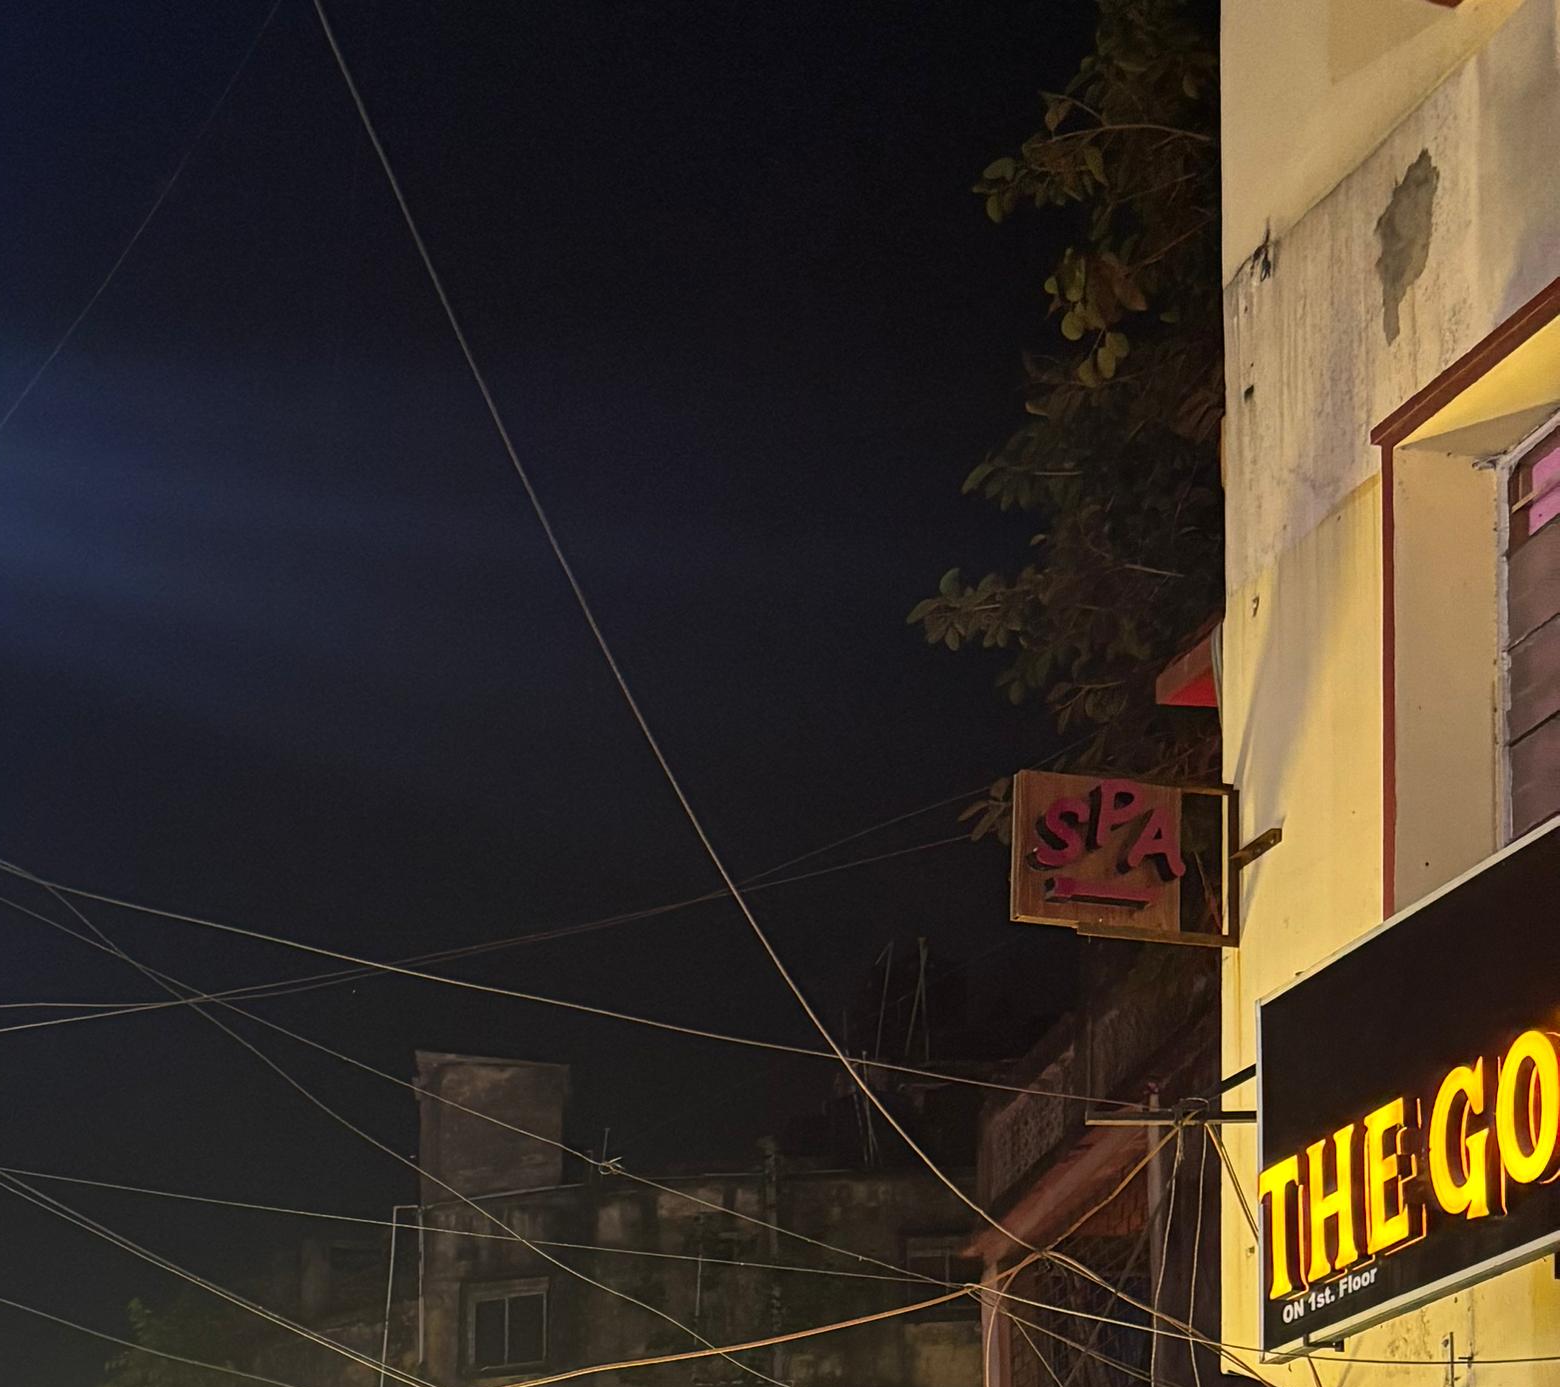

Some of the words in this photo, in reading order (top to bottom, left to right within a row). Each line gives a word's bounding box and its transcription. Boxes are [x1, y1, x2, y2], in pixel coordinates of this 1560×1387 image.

[1034, 777, 1185, 878] SPA
[1259, 1098, 1410, 1300] THE
[1282, 1298, 1306, 1324] ON
[1307, 1285, 1336, 1312] 1st.
[1339, 1266, 1379, 1298] Floor
